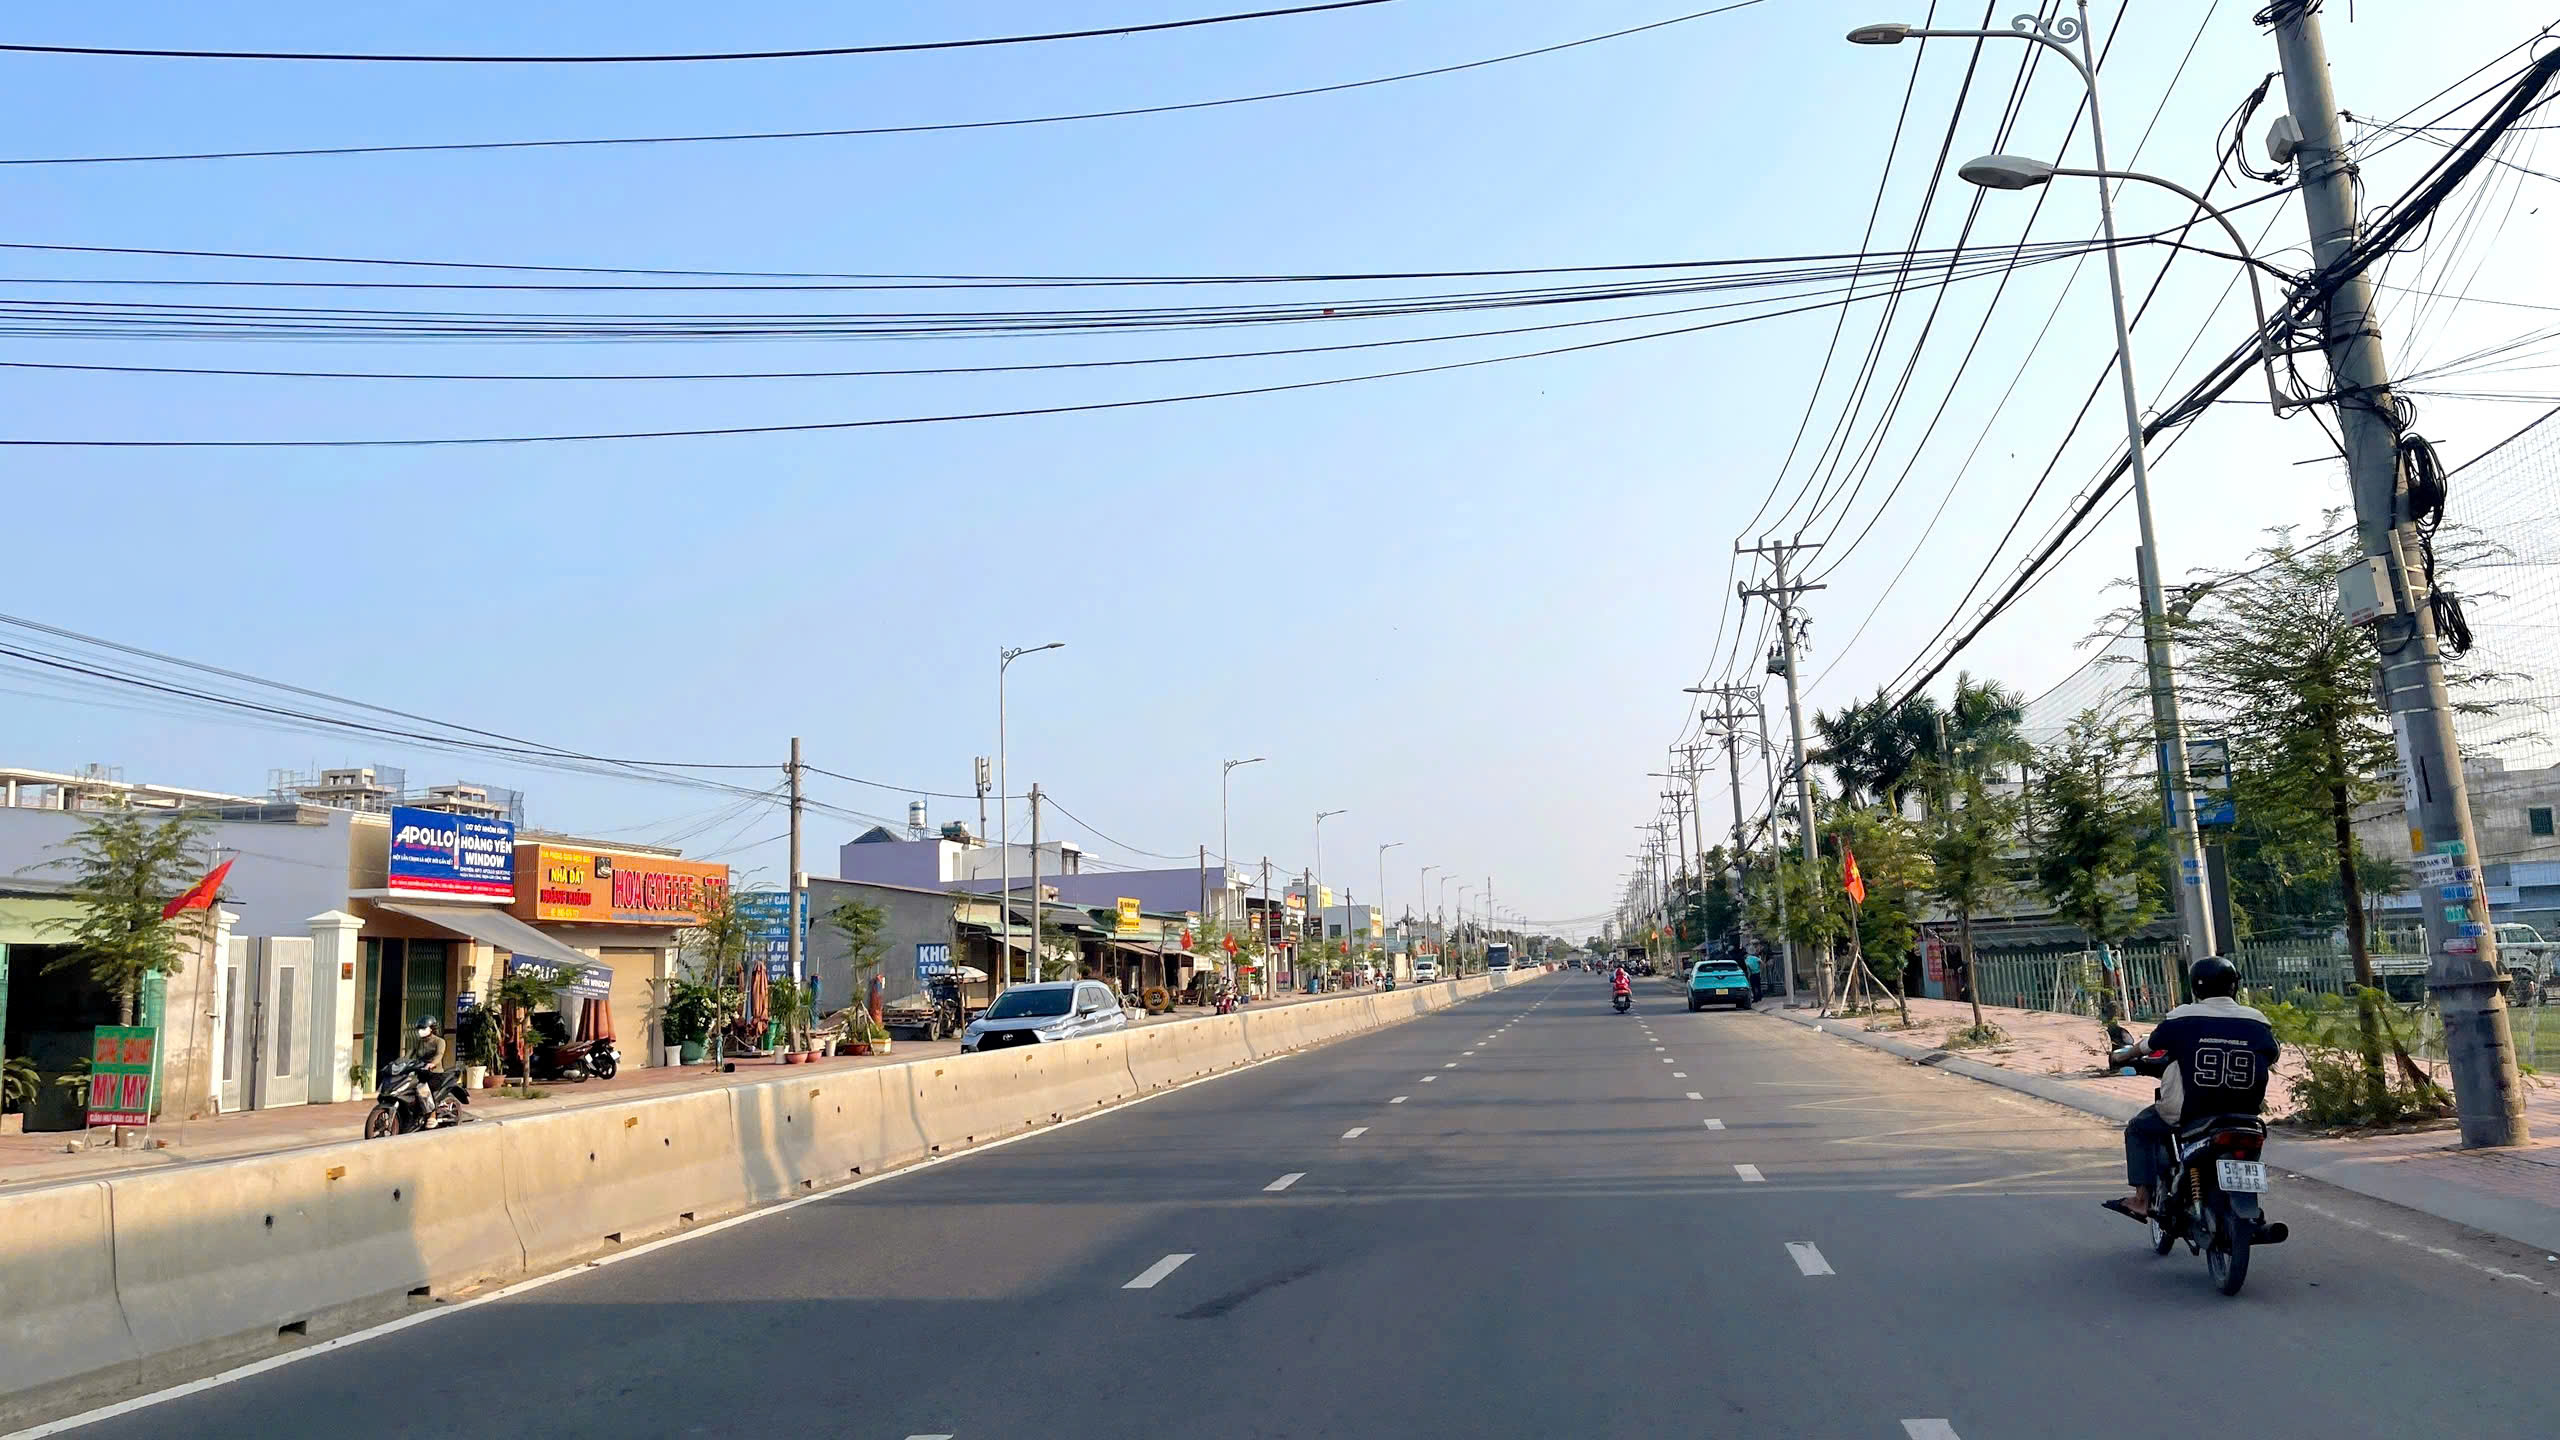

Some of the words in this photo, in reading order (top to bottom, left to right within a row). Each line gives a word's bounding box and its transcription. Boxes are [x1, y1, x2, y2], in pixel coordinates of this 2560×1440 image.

[396, 825, 455, 848] APOLLO
[460, 834, 494, 852] HOÀNG
[494, 836, 513, 854] YẾN
[464, 851, 506, 868] WINDOW
[550, 865, 568, 883] NHÀ
[568, 866, 585, 885] ĐẤT
[613, 868, 645, 908] HOA
[645, 871, 695, 911] COFFEE
[919, 945, 950, 962] KHO
[2194, 1048, 2256, 1089] 99
